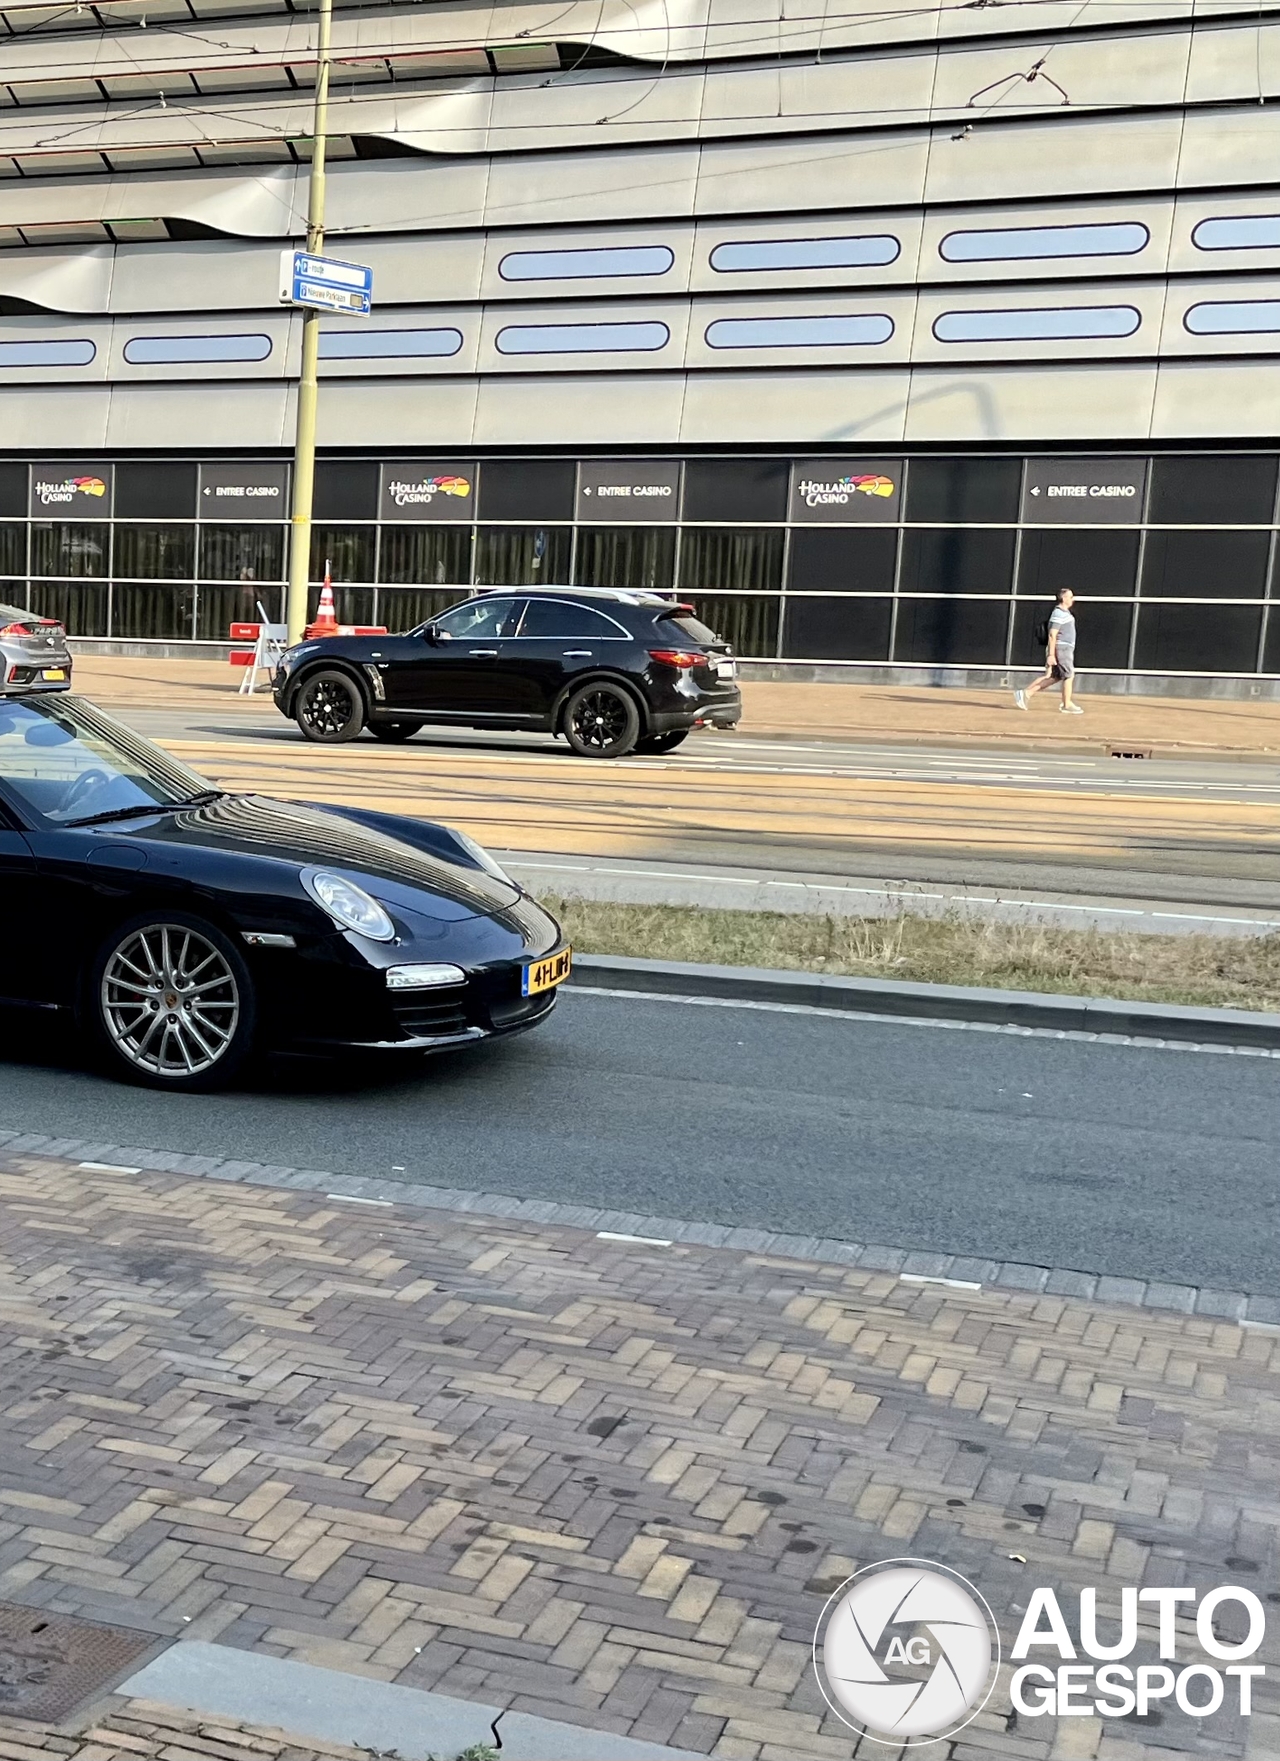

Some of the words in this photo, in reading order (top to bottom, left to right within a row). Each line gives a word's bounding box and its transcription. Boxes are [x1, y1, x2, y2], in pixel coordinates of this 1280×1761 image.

[35, 482, 77, 495] HOLLAND
[216, 487, 245, 496] ENTREE
[246, 487, 279, 496] CASINO
[388, 481, 437, 496] HOLLAND
[597, 486, 631, 496] ENTREE
[632, 486, 672, 496] CASINO
[798, 481, 856, 496] HOLLAND
[1047, 486, 1088, 497] ENTREE
[1089, 486, 1136, 497] CASINO
[41, 493, 73, 504] CASINO
[395, 493, 432, 506] CASINO
[806, 493, 849, 507] CASINO
